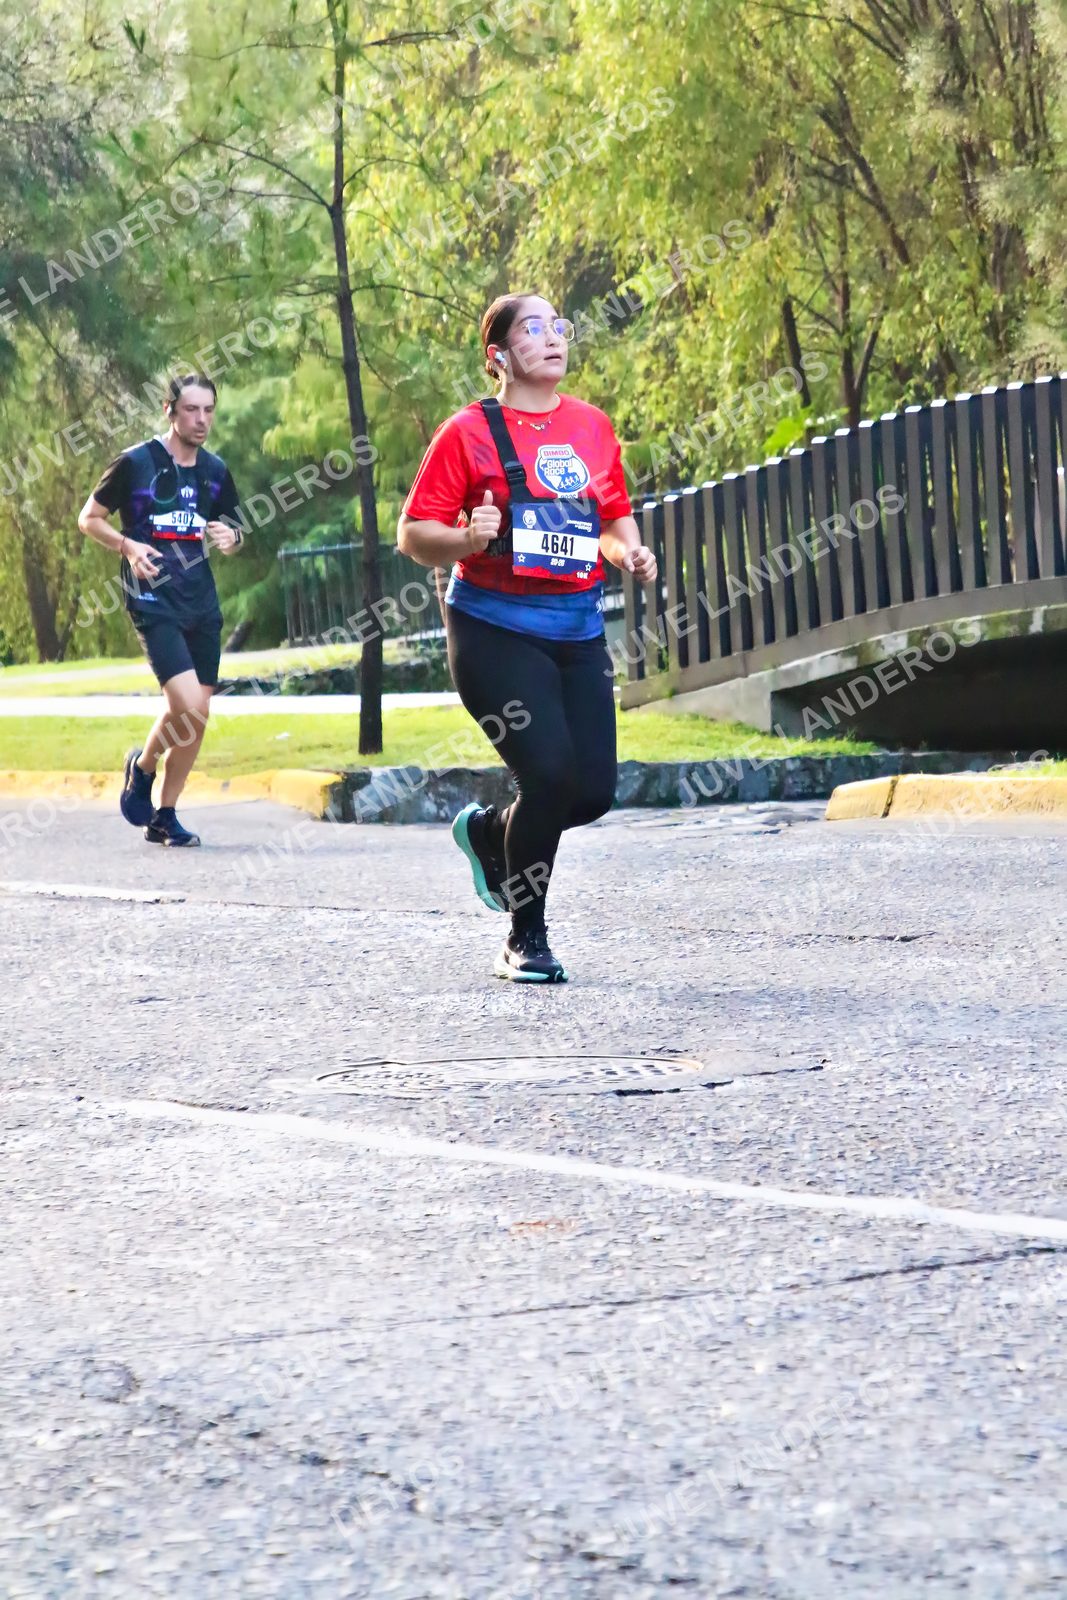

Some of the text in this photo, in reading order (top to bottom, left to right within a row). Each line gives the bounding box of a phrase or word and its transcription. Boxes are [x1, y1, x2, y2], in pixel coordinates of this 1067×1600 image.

[547, 459, 572, 468] Global
[544, 467, 565, 476] Race
[541, 533, 575, 556] 4641
